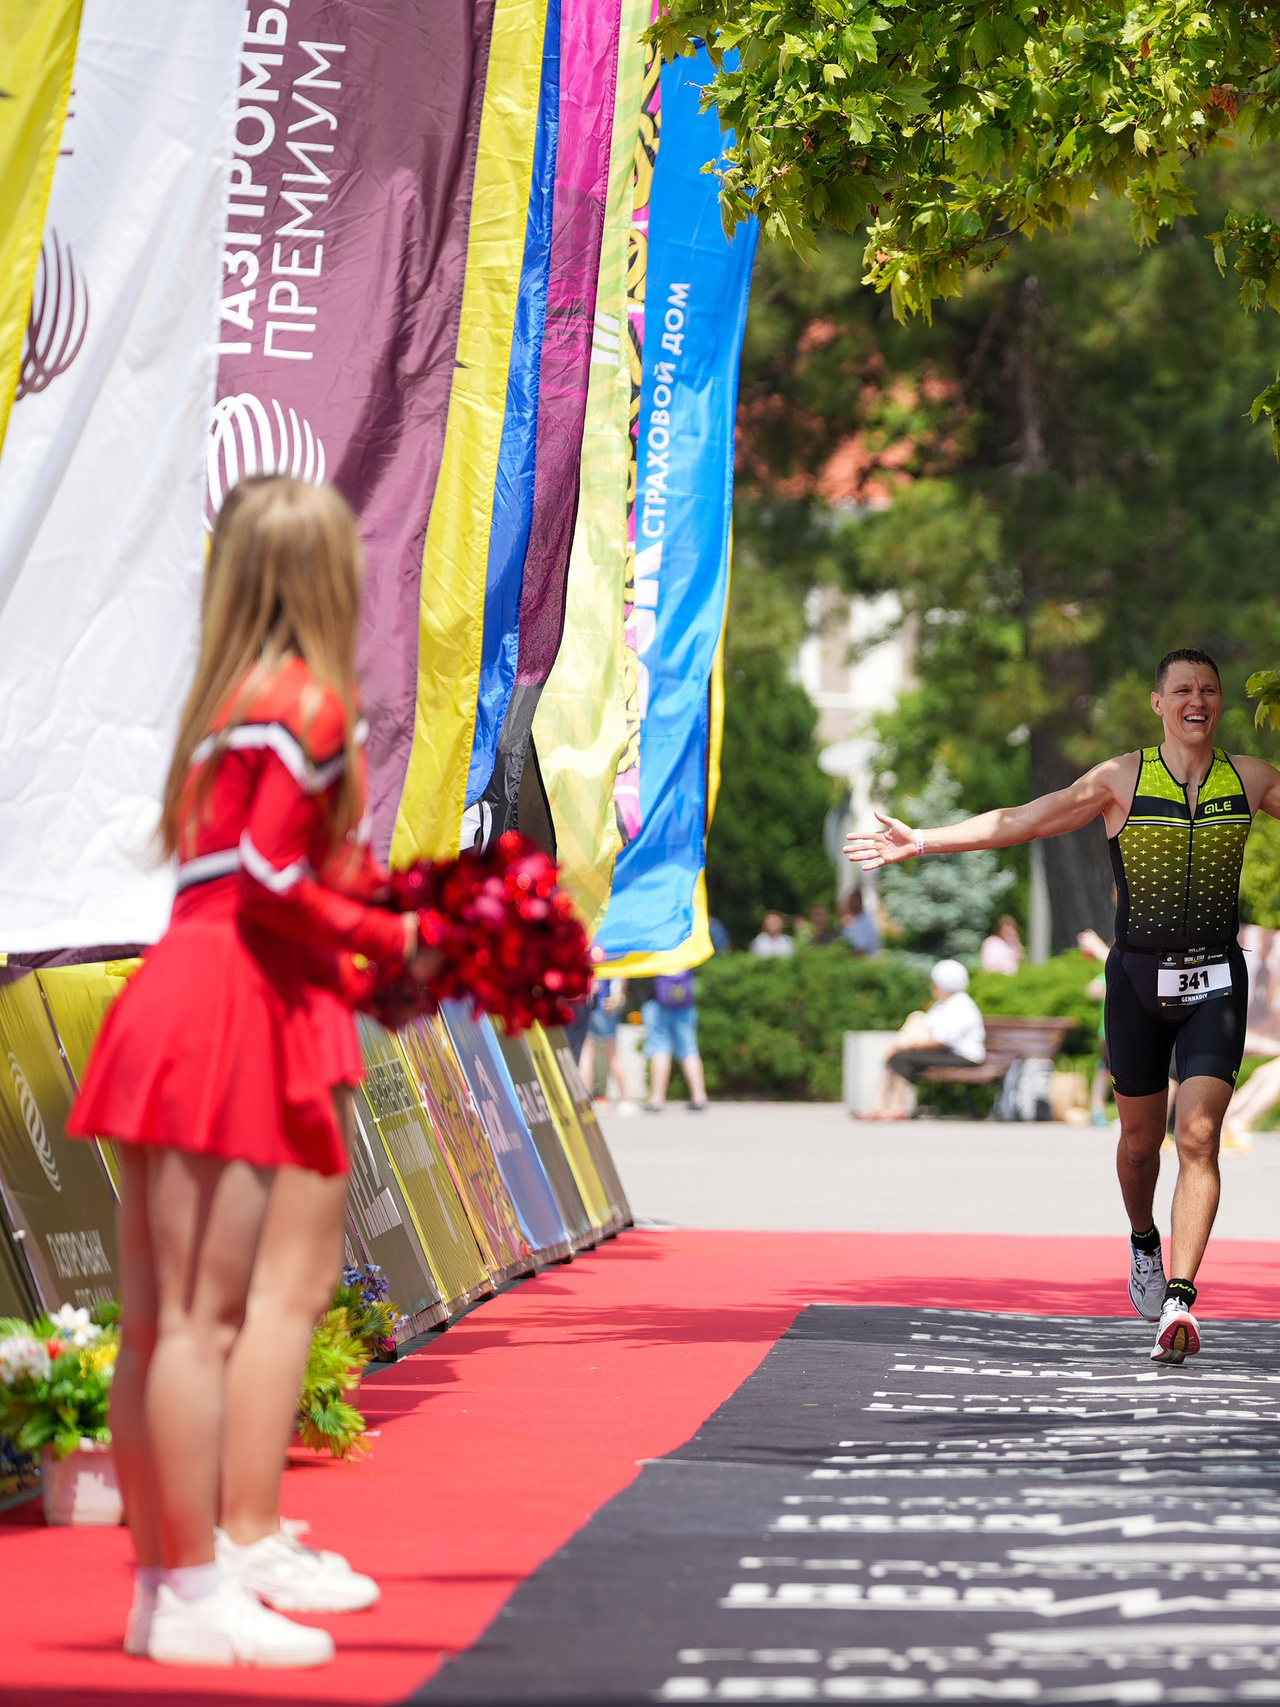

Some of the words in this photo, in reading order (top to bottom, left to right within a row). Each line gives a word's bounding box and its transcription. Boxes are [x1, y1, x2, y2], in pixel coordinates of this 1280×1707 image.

[263, 40, 346, 361] ПРЕМИУМ
[642, 362, 676, 539] СТРАХОВОЙ
[660, 282, 691, 357] ДОМ
[1178, 970, 1210, 992] 341
[1181, 993, 1208, 1003] GENNADIY
[895, 1364, 1093, 1378] IRON
